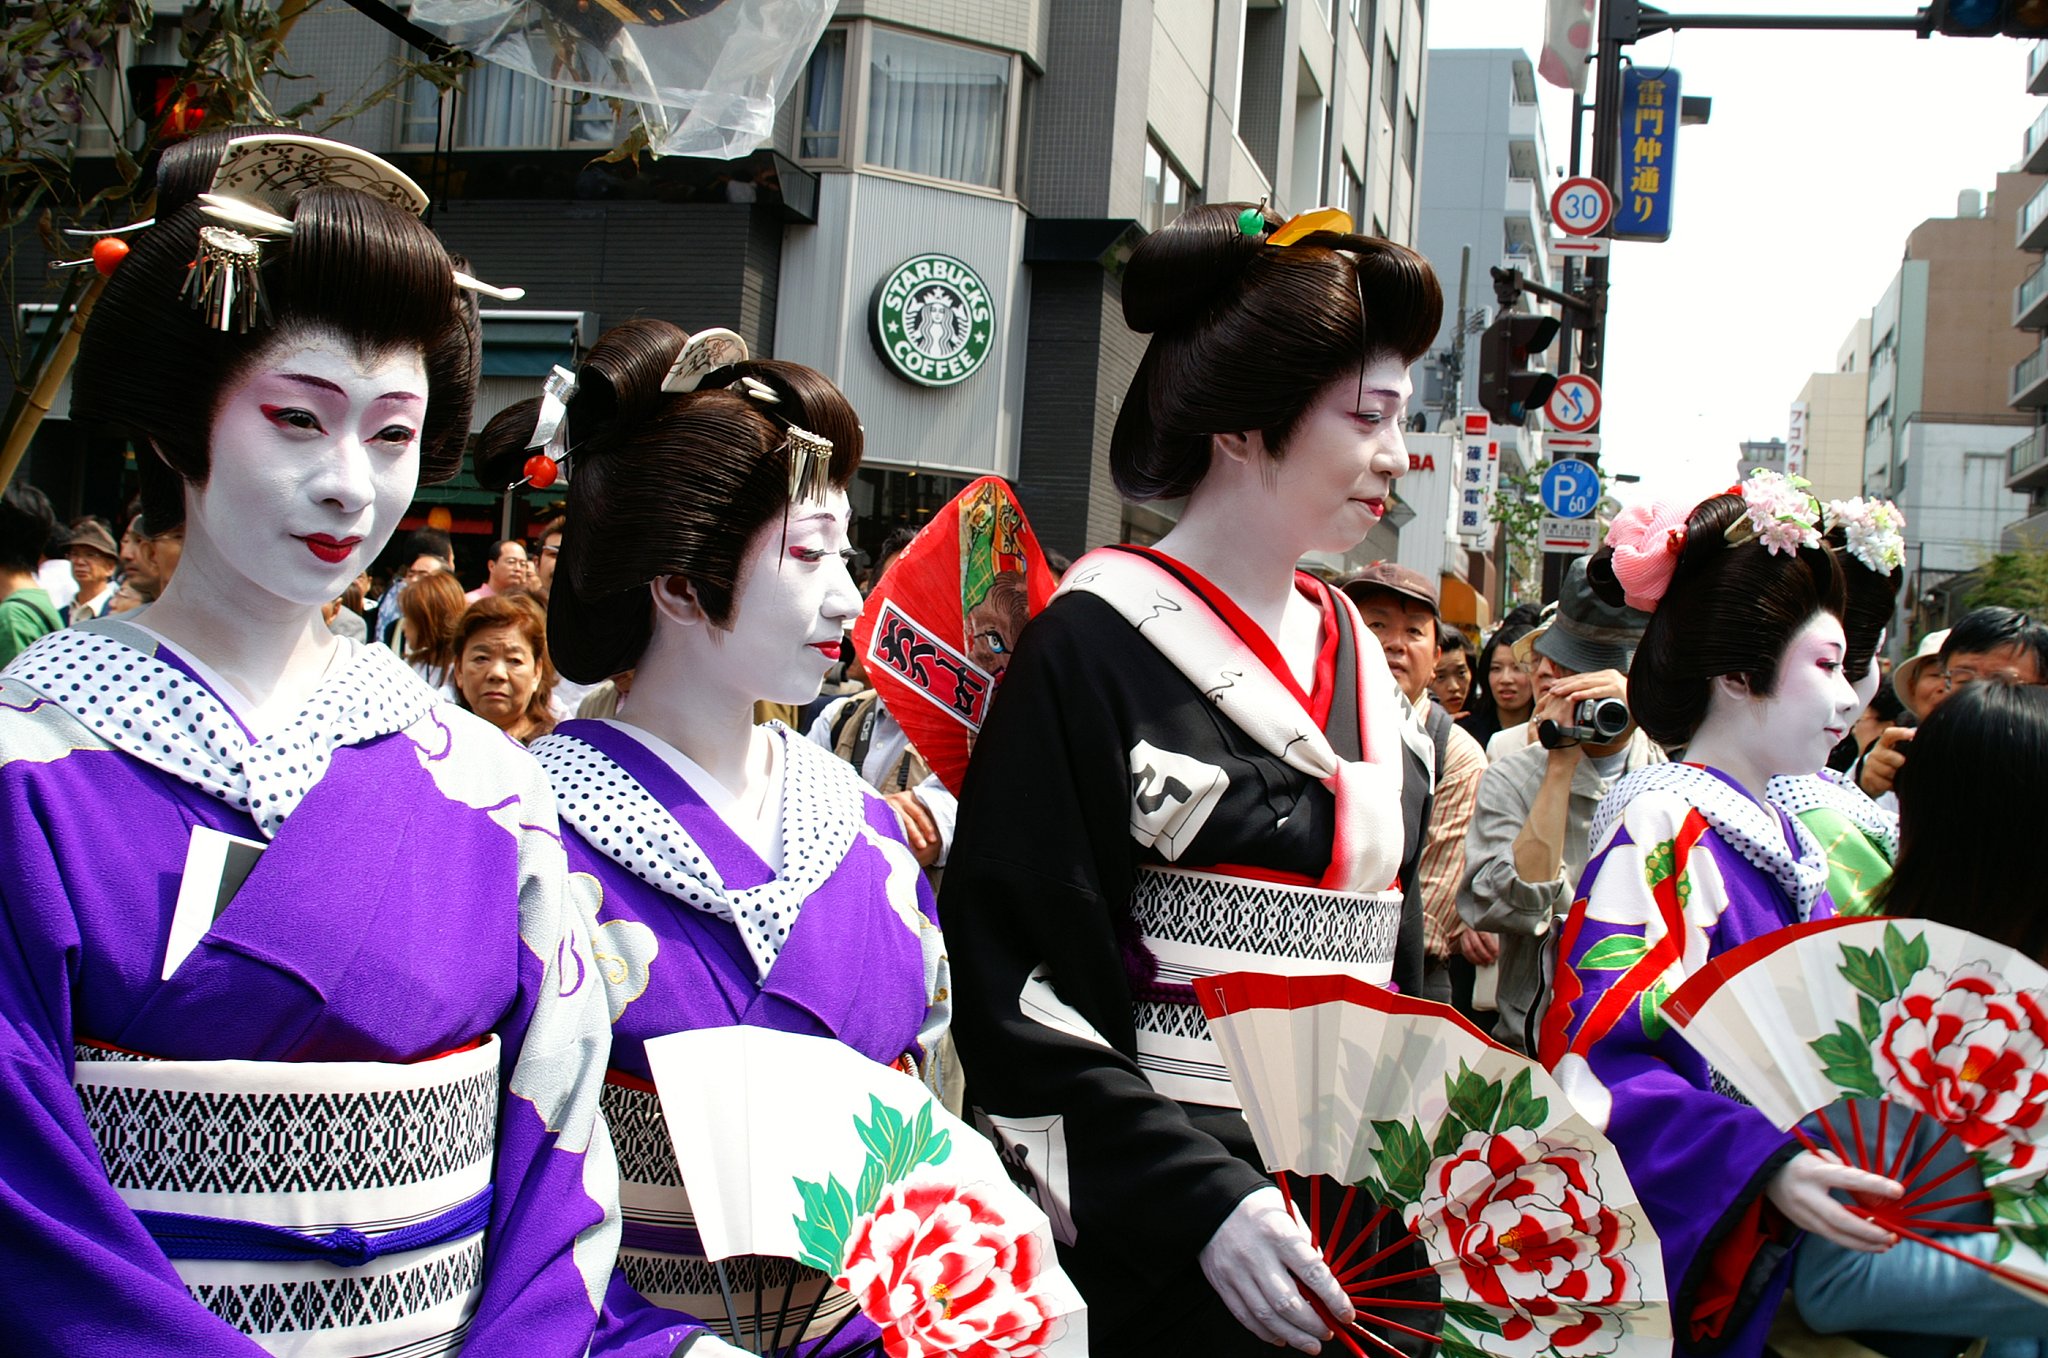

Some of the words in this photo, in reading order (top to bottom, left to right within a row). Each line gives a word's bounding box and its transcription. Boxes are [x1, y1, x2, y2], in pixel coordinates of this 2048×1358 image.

[1631, 79, 1666, 223] 雷門仲通り
[1565, 194, 1597, 219] 30
[885, 260, 989, 323] STARBUCKS
[894, 340, 975, 379] COFFEE
[1553, 475, 1577, 512] P
[1568, 496, 1586, 512] 60
